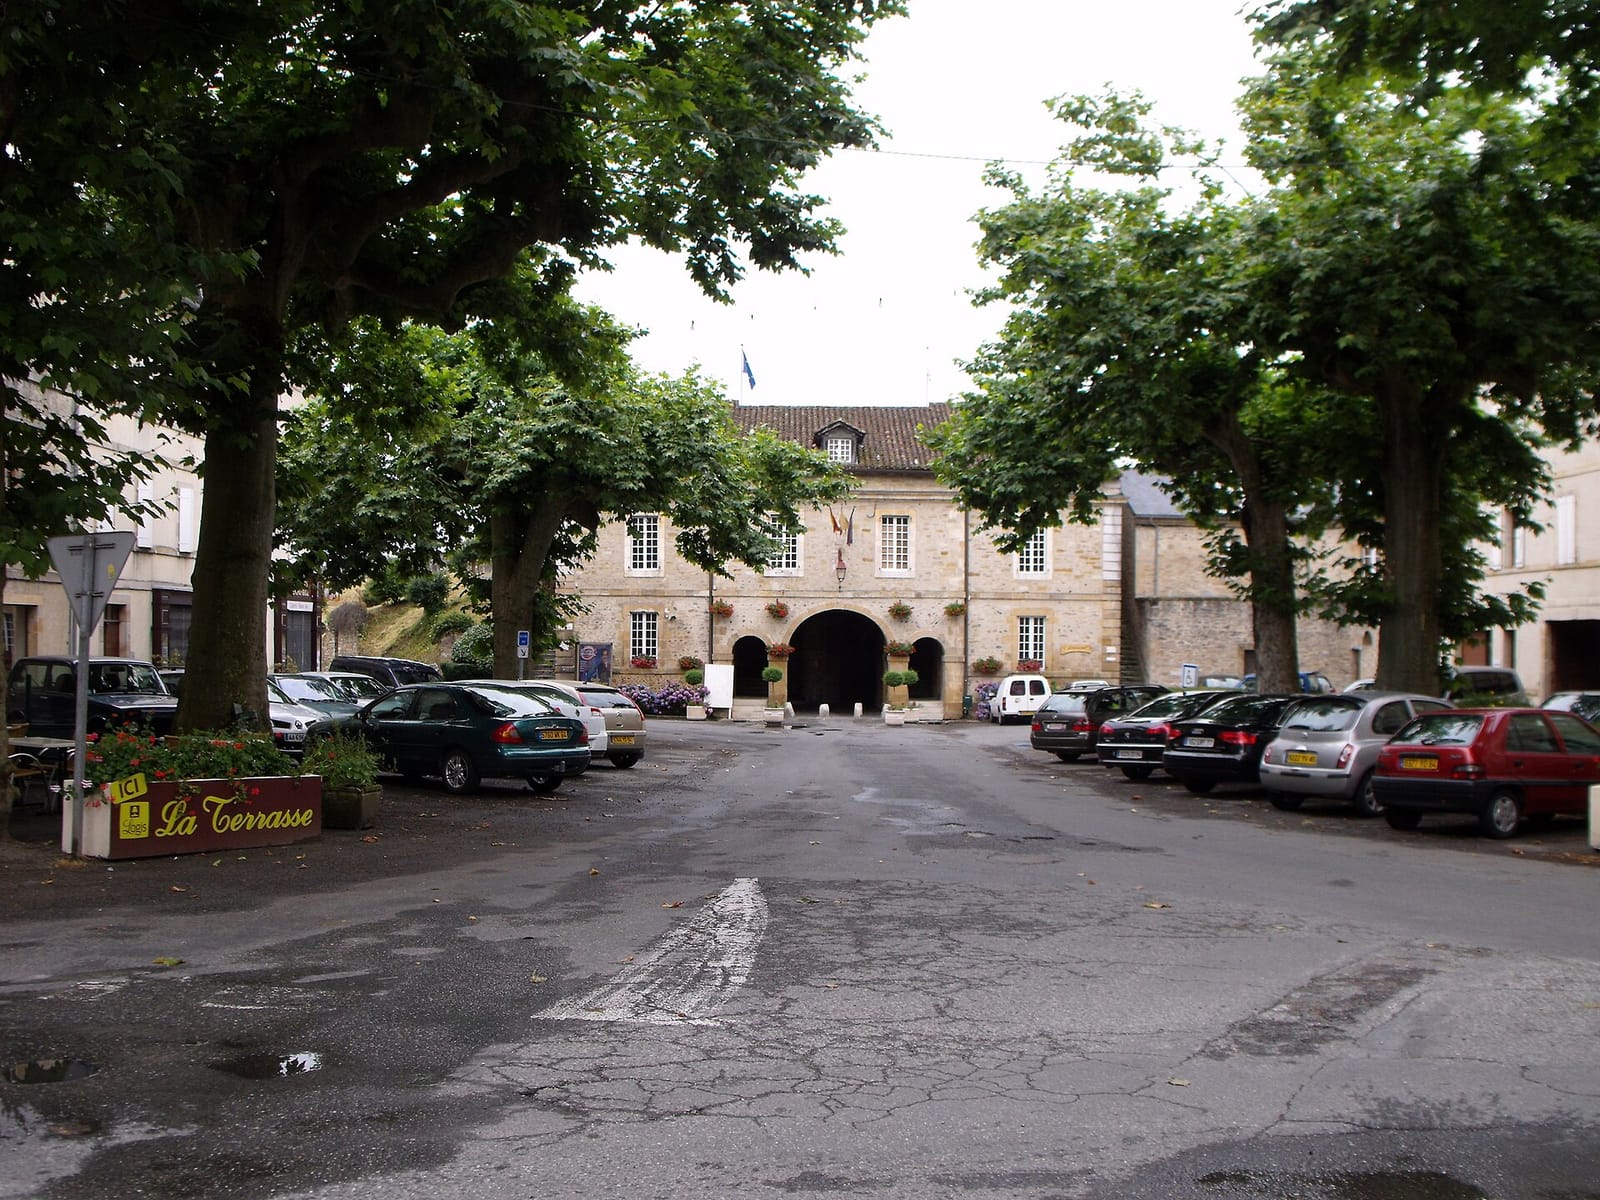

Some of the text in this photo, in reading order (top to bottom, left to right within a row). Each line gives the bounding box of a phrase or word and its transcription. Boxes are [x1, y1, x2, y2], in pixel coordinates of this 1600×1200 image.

[118, 778, 139, 798] ICI
[154, 795, 314, 837] La Terrasse
[122, 819, 147, 836] Logis
